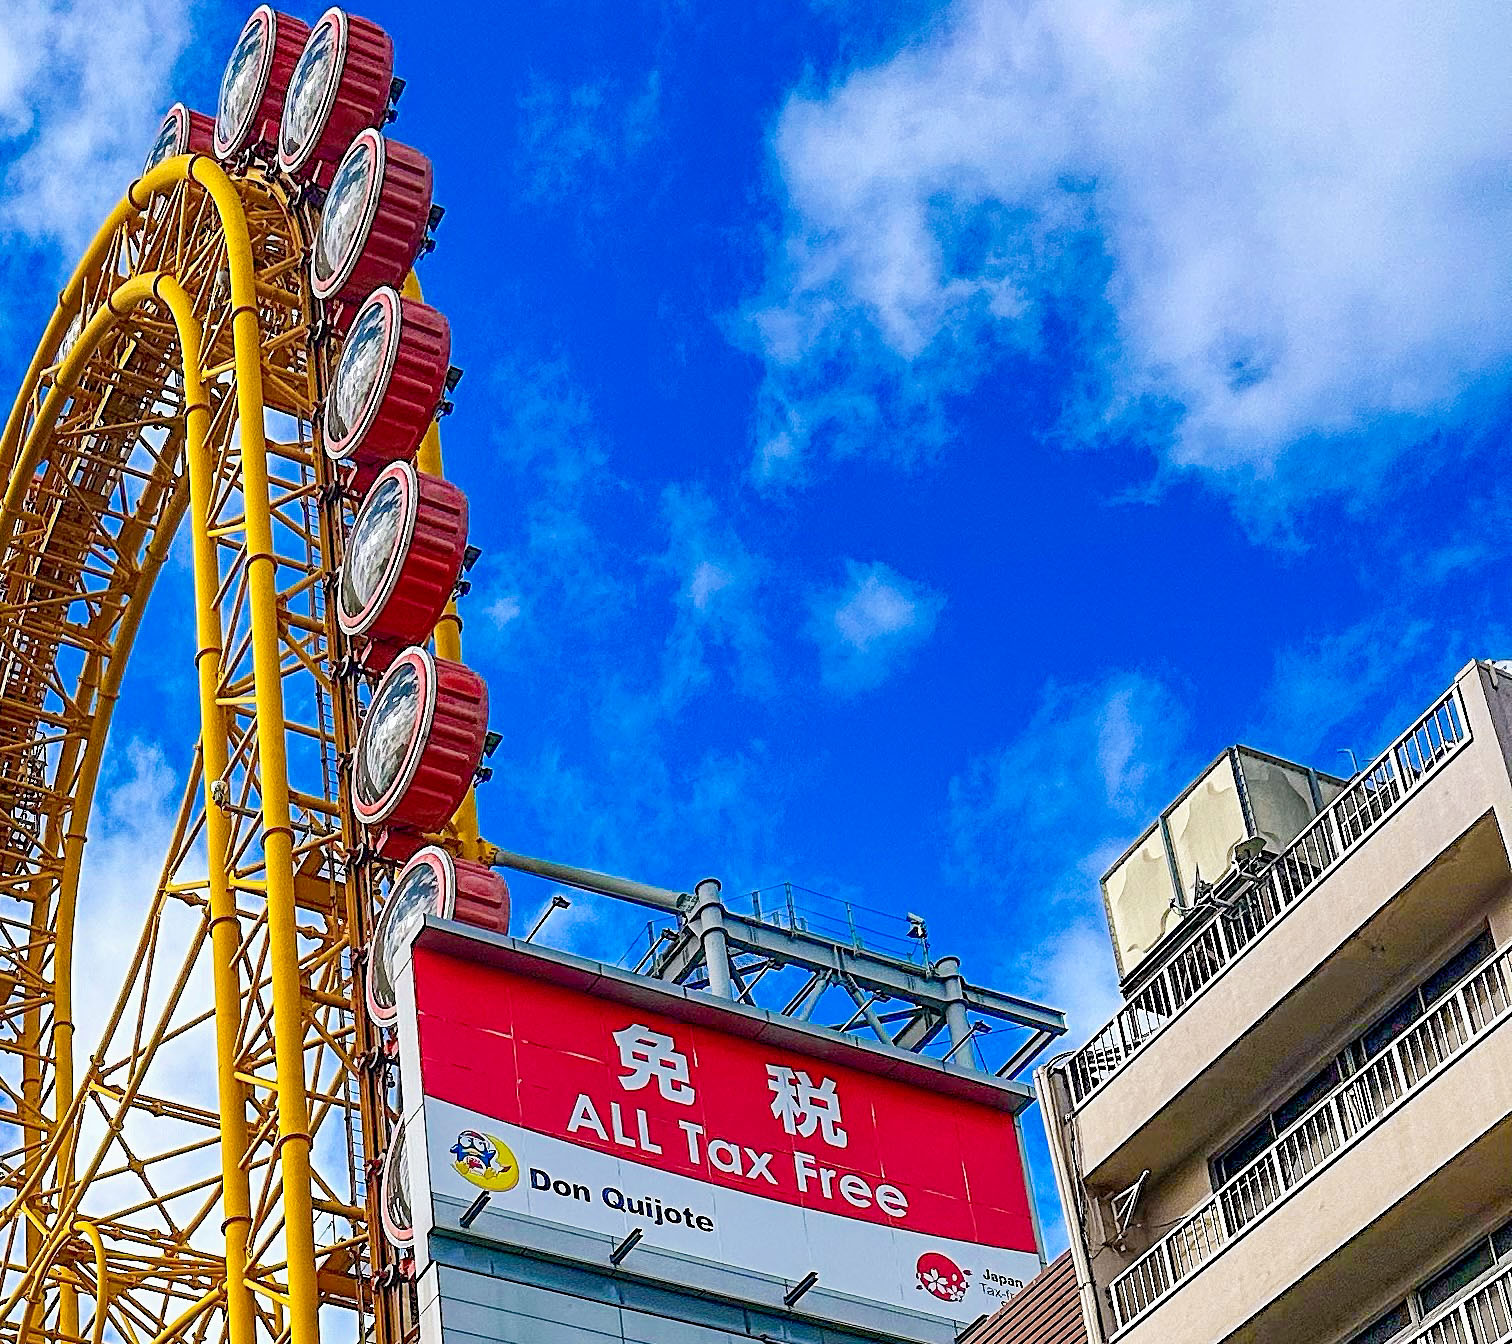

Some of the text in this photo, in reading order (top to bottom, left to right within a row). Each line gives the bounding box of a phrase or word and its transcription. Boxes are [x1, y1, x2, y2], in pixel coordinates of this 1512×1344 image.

[567, 1093, 909, 1219] ALL Tax Free
[529, 1166, 715, 1234] Don Quijote
[982, 1268, 1025, 1290] Japan
